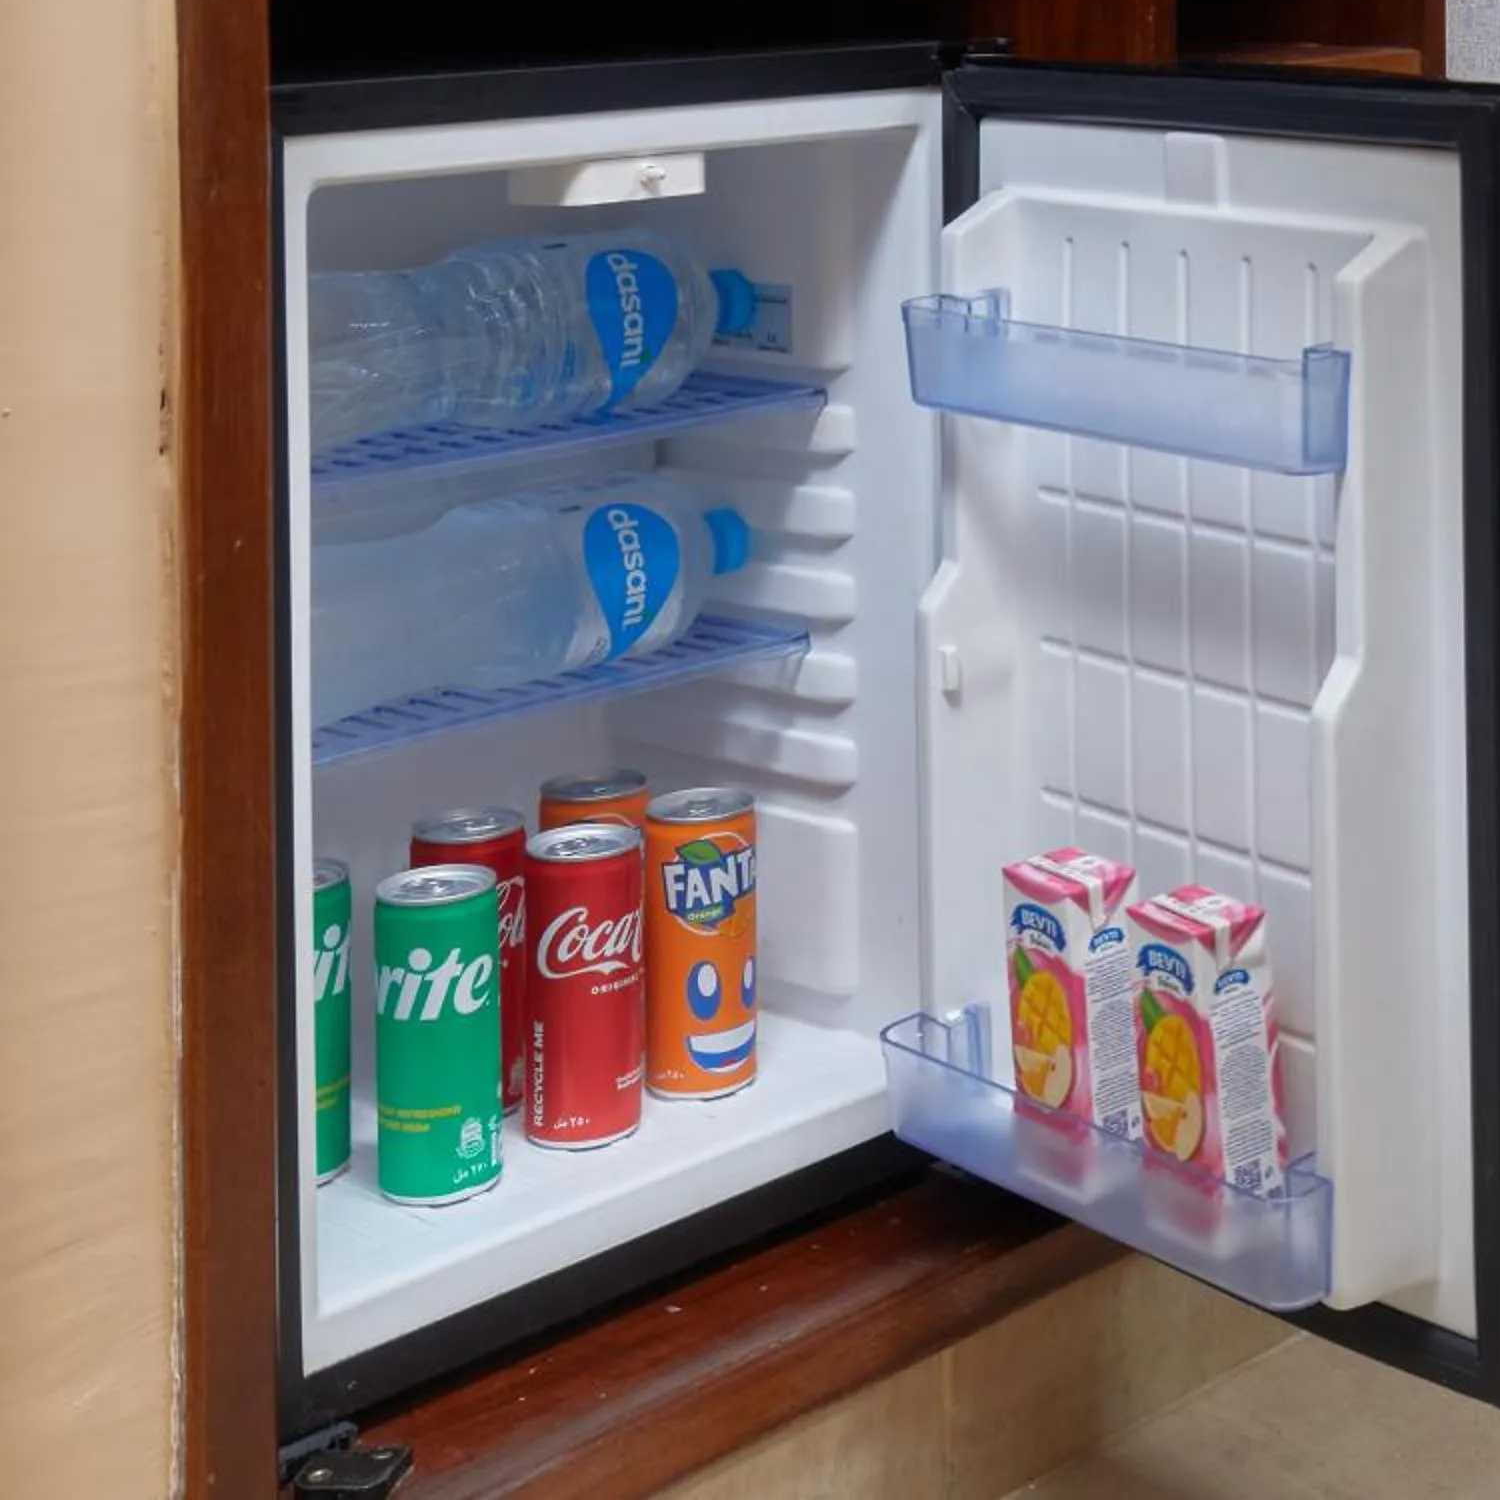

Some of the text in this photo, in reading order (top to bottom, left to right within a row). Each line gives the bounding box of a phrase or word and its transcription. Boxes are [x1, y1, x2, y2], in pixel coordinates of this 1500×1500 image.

[606, 252, 644, 368] dasani
[606, 508, 647, 632] dasani
[376, 947, 492, 1021] rite
[537, 906, 642, 979] Coca
[533, 1020, 544, 1126] RECYCLE ME
